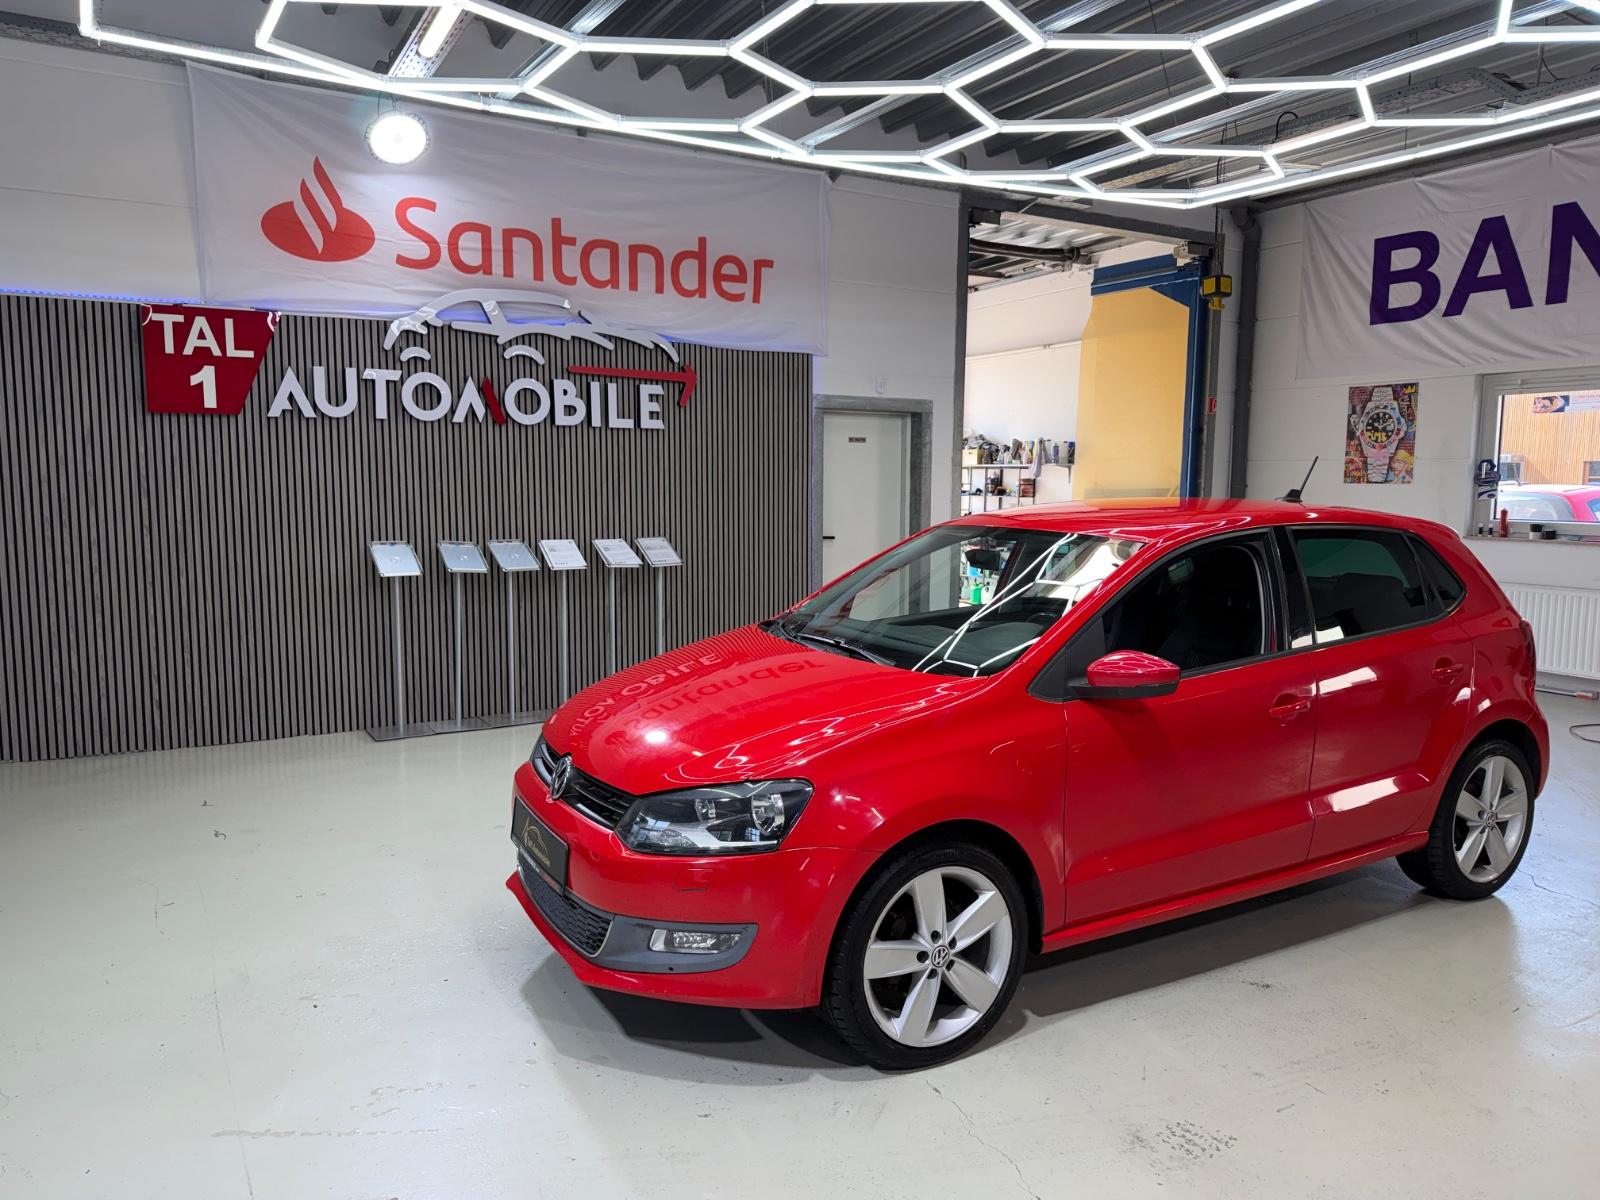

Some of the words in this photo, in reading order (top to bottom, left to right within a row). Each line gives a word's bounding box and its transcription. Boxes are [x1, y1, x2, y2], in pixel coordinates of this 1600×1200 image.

[395, 196, 774, 304] Santander
[151, 312, 255, 359] TAL
[189, 364, 218, 409] 1
[267, 365, 666, 430] AUTOMOBILE
